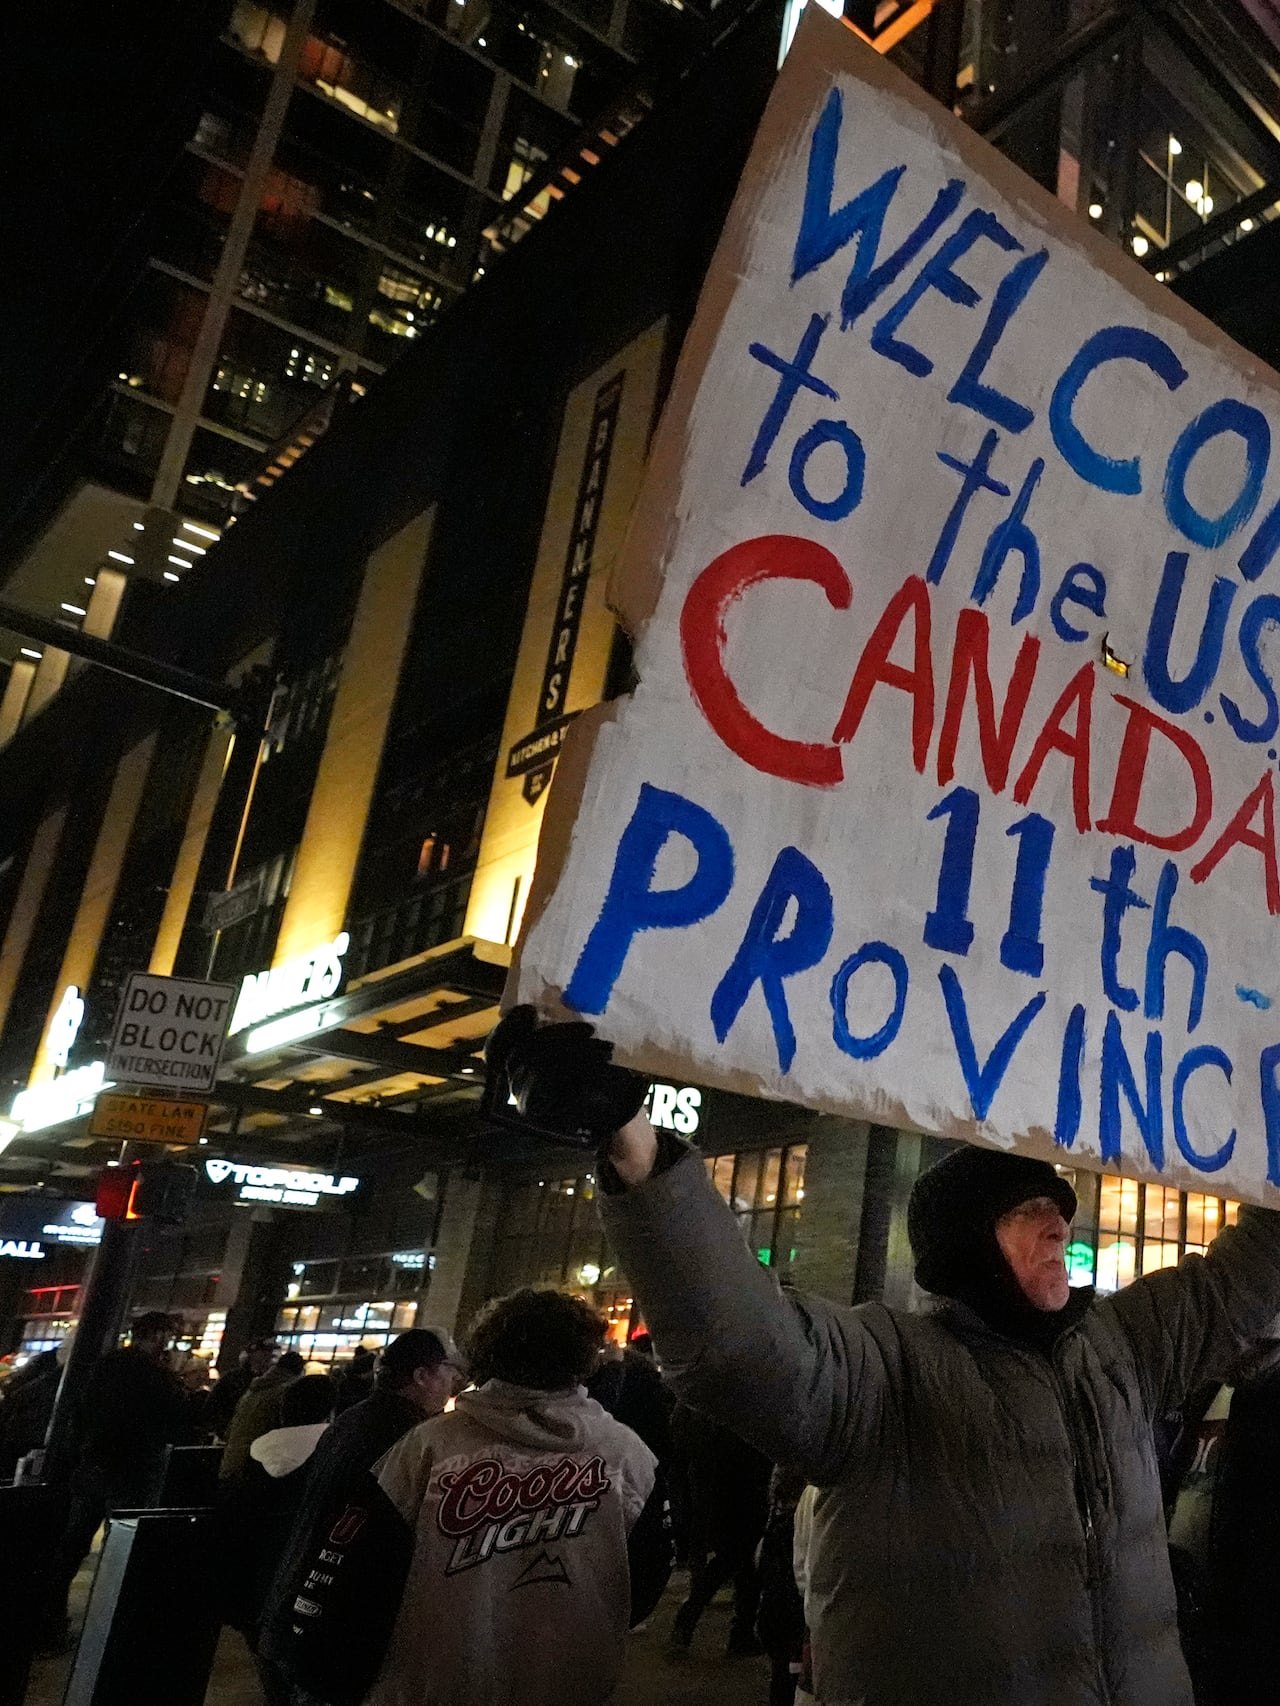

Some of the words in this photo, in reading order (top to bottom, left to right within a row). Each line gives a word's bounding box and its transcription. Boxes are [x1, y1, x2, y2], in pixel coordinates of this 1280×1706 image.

[739, 312, 866, 521] to
[926, 427, 1107, 642] the
[546, 418, 609, 712] BANNERS
[128, 987, 166, 1015] DO
[174, 994, 229, 1023] NOT
[119, 1022, 220, 1057] BLOCK
[109, 1055, 213, 1082] INTERSECTION
[106, 1099, 156, 1117] STATE
[161, 1102, 196, 1120] LAW
[149, 1121, 189, 1139] FINE
[0, 1240, 46, 1259] ALL
[438, 1456, 611, 1538] Coors
[445, 1500, 600, 1578] LIGHT
